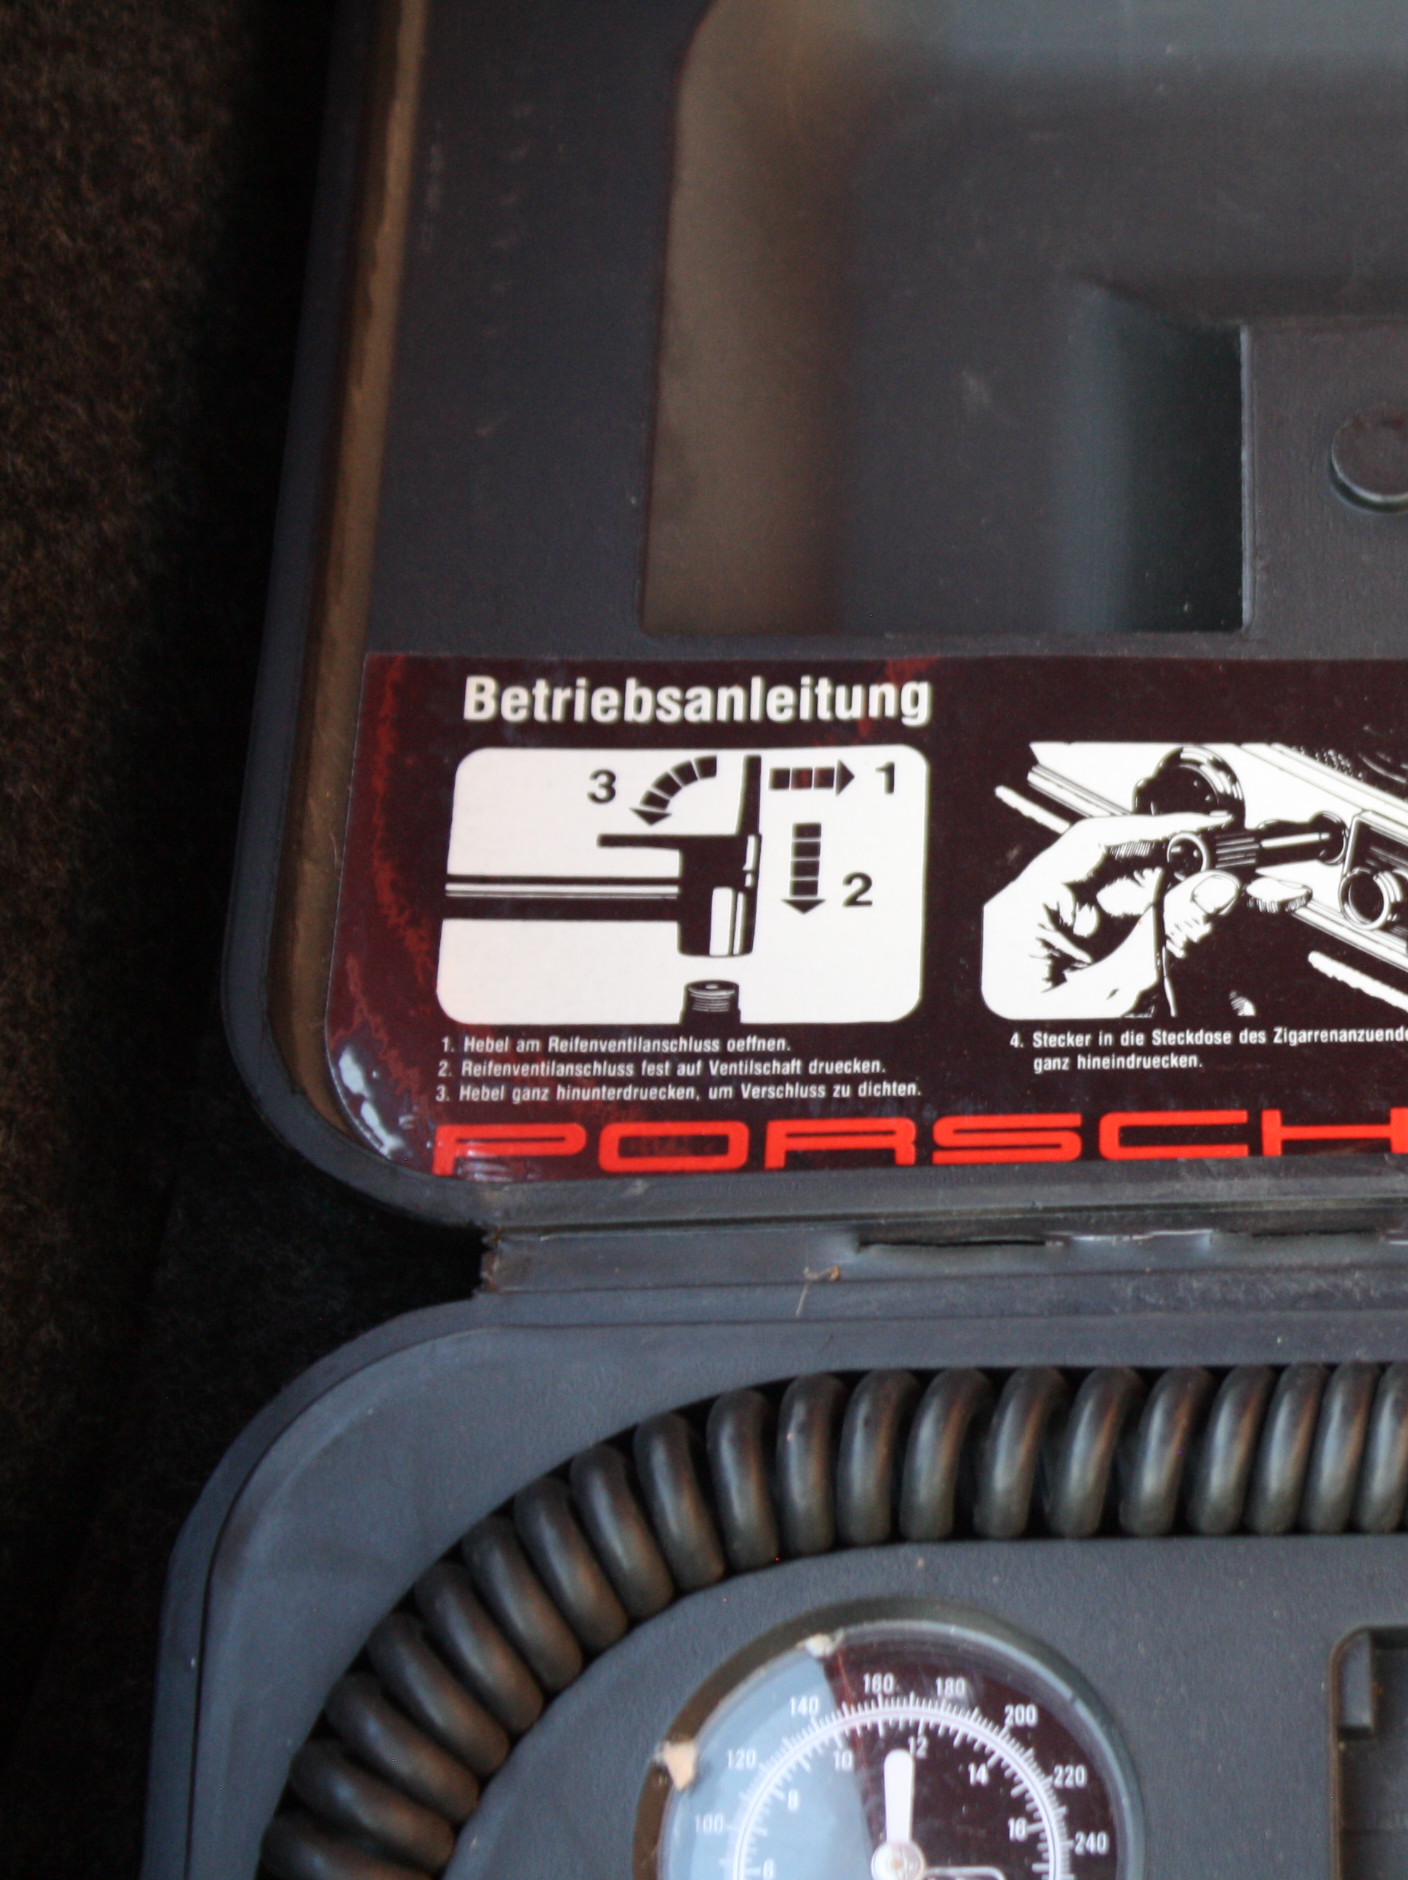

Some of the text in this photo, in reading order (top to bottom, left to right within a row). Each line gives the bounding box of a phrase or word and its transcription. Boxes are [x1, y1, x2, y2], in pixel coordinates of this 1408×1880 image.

[463, 675, 931, 728] Betriebsanleitung
[587, 770, 617, 804] 3
[876, 762, 896, 794] 1
[843, 873, 873, 907] 2
[441, 1035, 791, 1053] 1. Hebel am Reifenventilanschluss oeffnen.
[1009, 1031, 1025, 1049] 4.
[1032, 1030, 1092, 1049] Stecker
[1098, 1030, 1115, 1047] in
[1119, 1029, 1146, 1047] die
[1151, 1027, 1234, 1046] Steckdose
[1238, 1027, 1268, 1045] des
[437, 1057, 886, 1078] 2. Reifenventilanschluss fest auf Ventilschaft druecken.
[1032, 1053, 1203, 1075] ganz hineindruecken.
[435, 1080, 922, 1105] 3. Hebel ganz hinunterdruecken, um Verschluss zu dichten.
[863, 1675, 894, 1693] 160
[936, 1678, 965, 1697] 180
[790, 1696, 818, 1716] 140
[1004, 1705, 1038, 1727] 200
[908, 1737, 927, 1757] 12
[727, 1750, 757, 1768] 120
[834, 1750, 853, 1769] 10
[969, 1764, 988, 1785] 14
[1054, 1766, 1087, 1788] 220
[1075, 1832, 1108, 1853] 240
